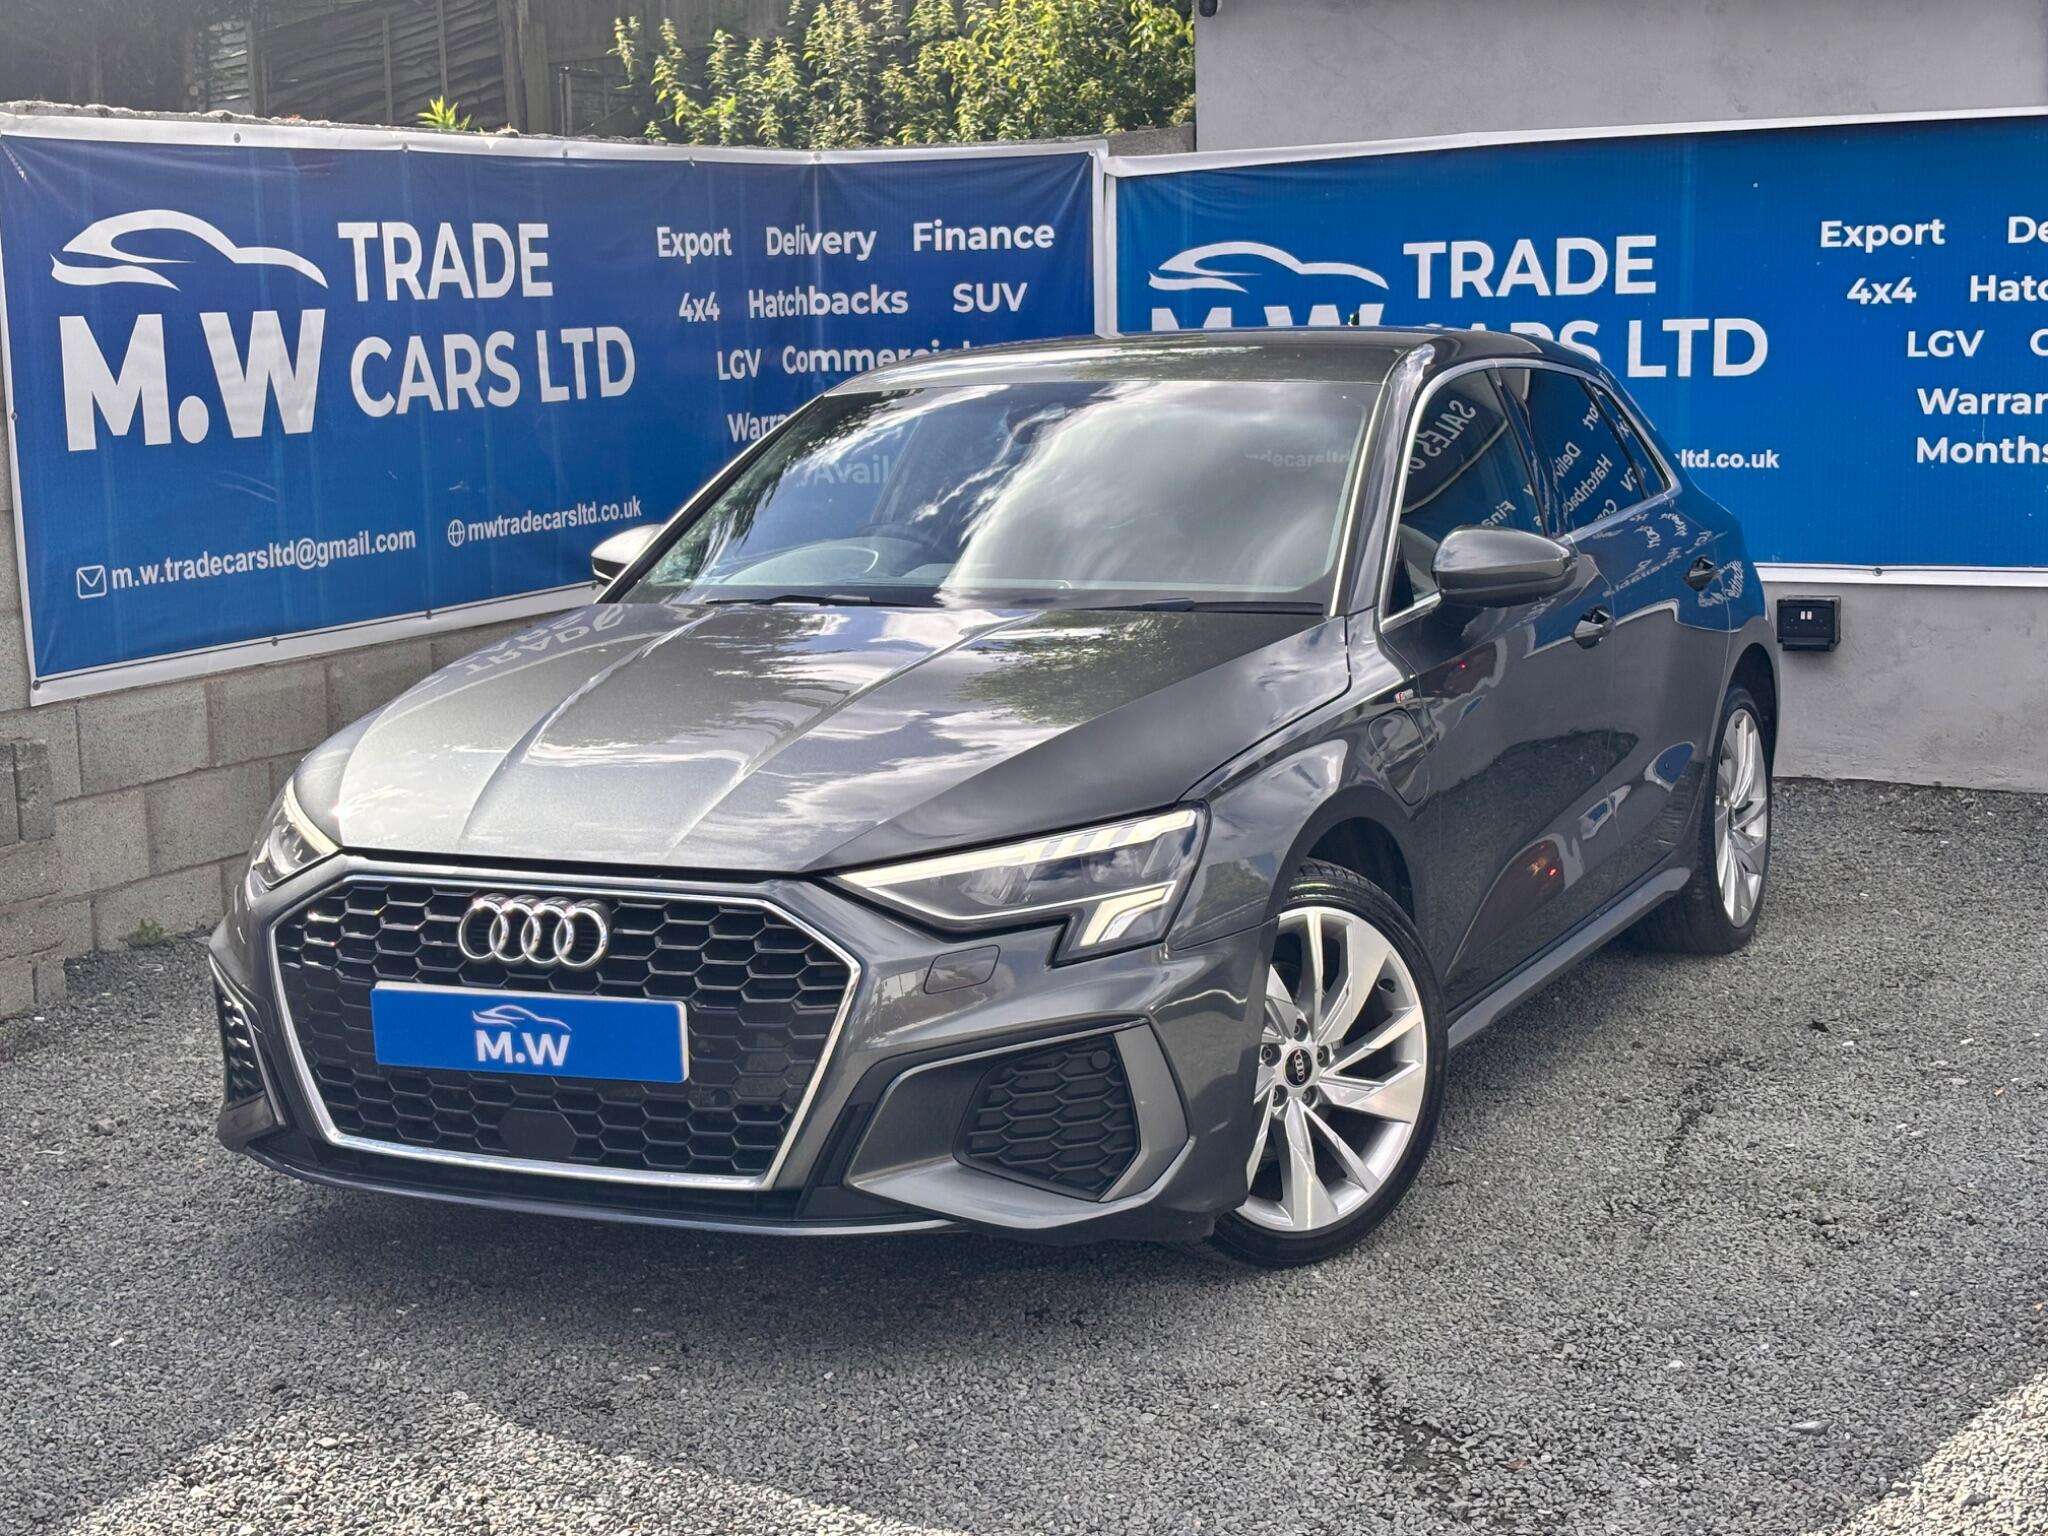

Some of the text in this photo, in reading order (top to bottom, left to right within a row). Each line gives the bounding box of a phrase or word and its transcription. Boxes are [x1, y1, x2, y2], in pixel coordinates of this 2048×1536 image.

[656, 218, 1056, 264] Export Delivery Finance
[1820, 218, 1946, 254] Export
[337, 221, 553, 302] TRADE
[1403, 235, 1657, 299] TRADE
[678, 282, 1029, 323] 4x4 Hatchbacks SUV
[1846, 276, 1917, 305] 4x4
[717, 348, 762, 381] LGV
[1627, 317, 1769, 378] LTD
[1907, 329, 1985, 358] LGV
[59, 308, 326, 452] M.W
[350, 326, 636, 418] CARS LTD
[468, 495, 642, 541] mwtradecarsltd.co.uk
[111, 529, 416, 590] m.w.tradecarsltd@gmail.com
[475, 1030, 571, 1067] M.W
